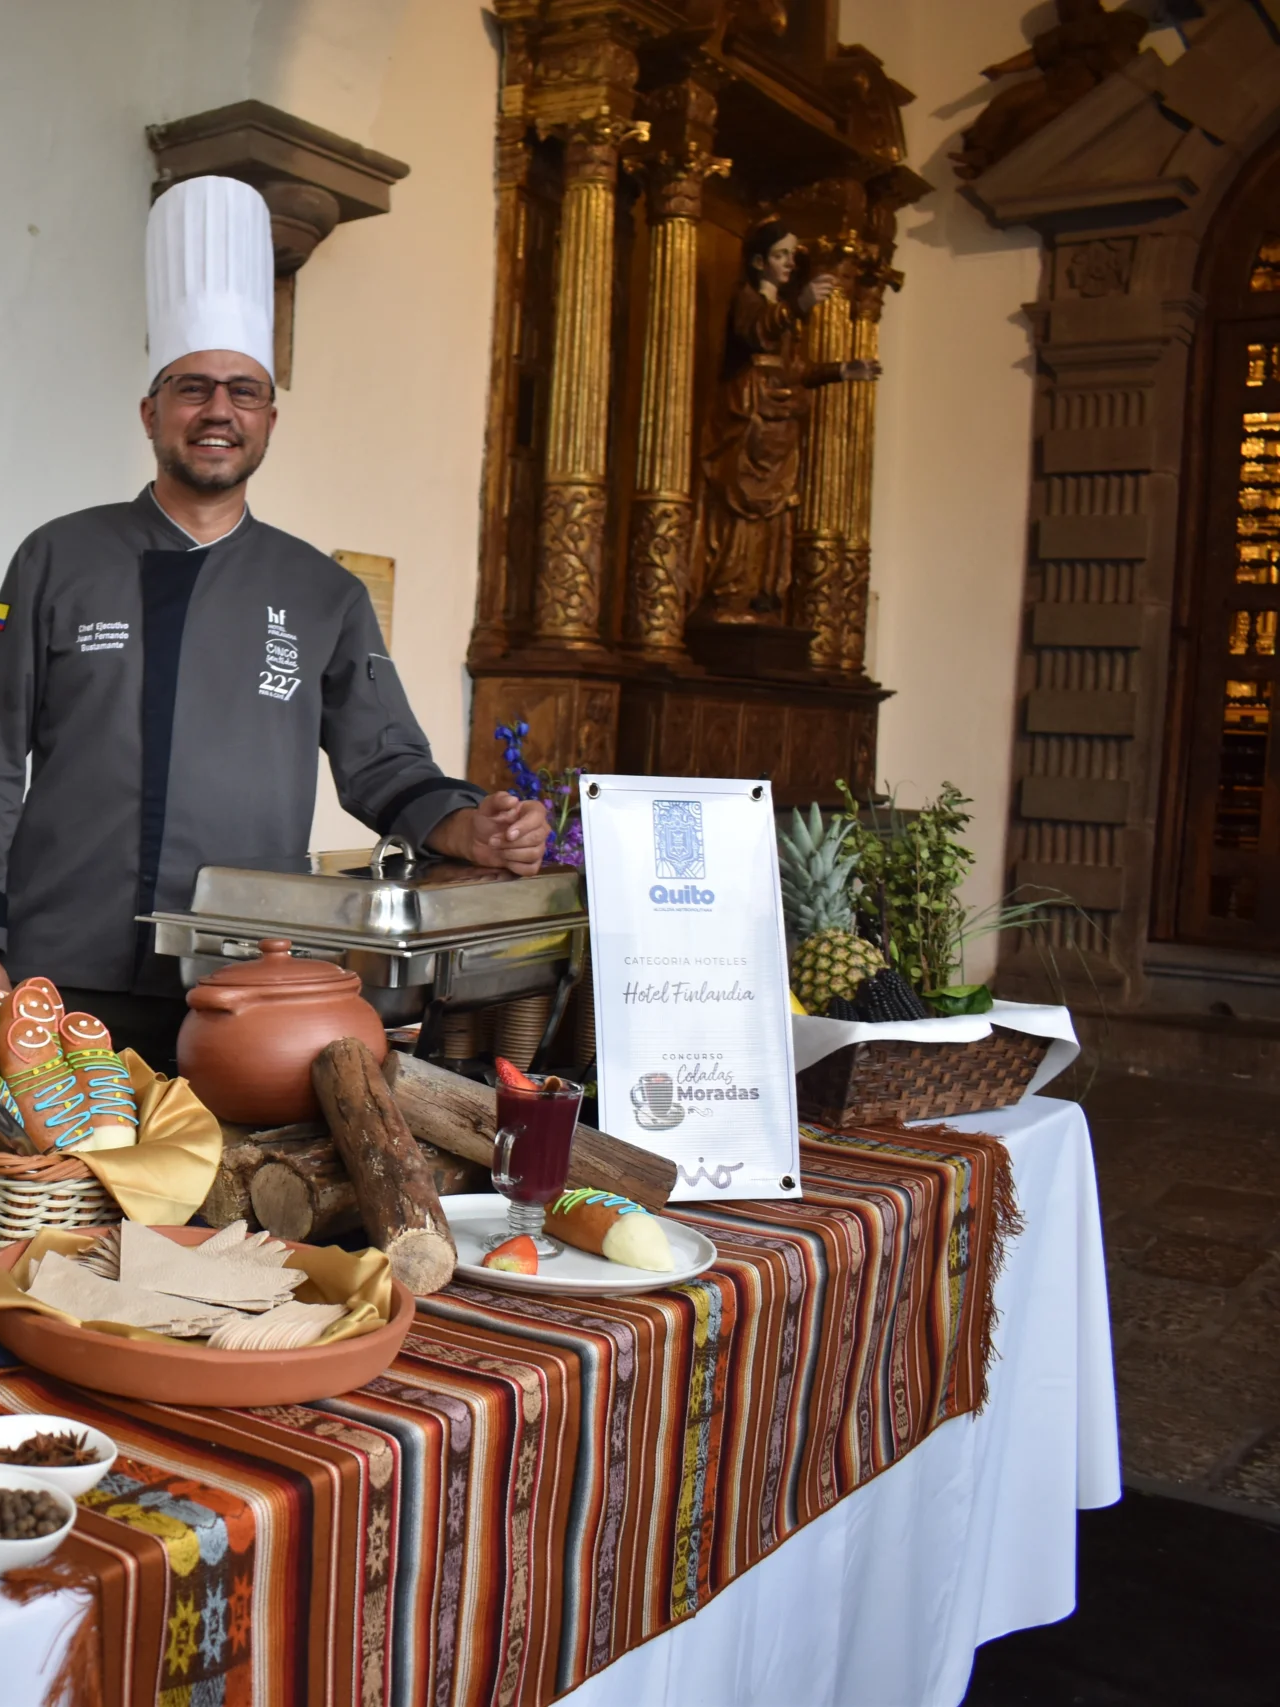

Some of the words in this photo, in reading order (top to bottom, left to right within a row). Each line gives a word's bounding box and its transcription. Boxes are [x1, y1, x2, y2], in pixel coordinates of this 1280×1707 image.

[267, 606, 286, 625] hf
[78, 622, 94, 633] Chef
[96, 621, 129, 631] Ejecutivo
[76, 634, 92, 643] Juan
[95, 631, 129, 640] Fernando
[81, 642, 124, 652] Bustamante
[259, 671, 301, 701] 227
[649, 885, 715, 905] Quito
[695, 957, 747, 966] HOTELES
[623, 980, 669, 1004] Hotel
[671, 980, 755, 1004] Finlandia
[677, 1062, 735, 1085] Coladas
[677, 1085, 760, 1102] Moradas
